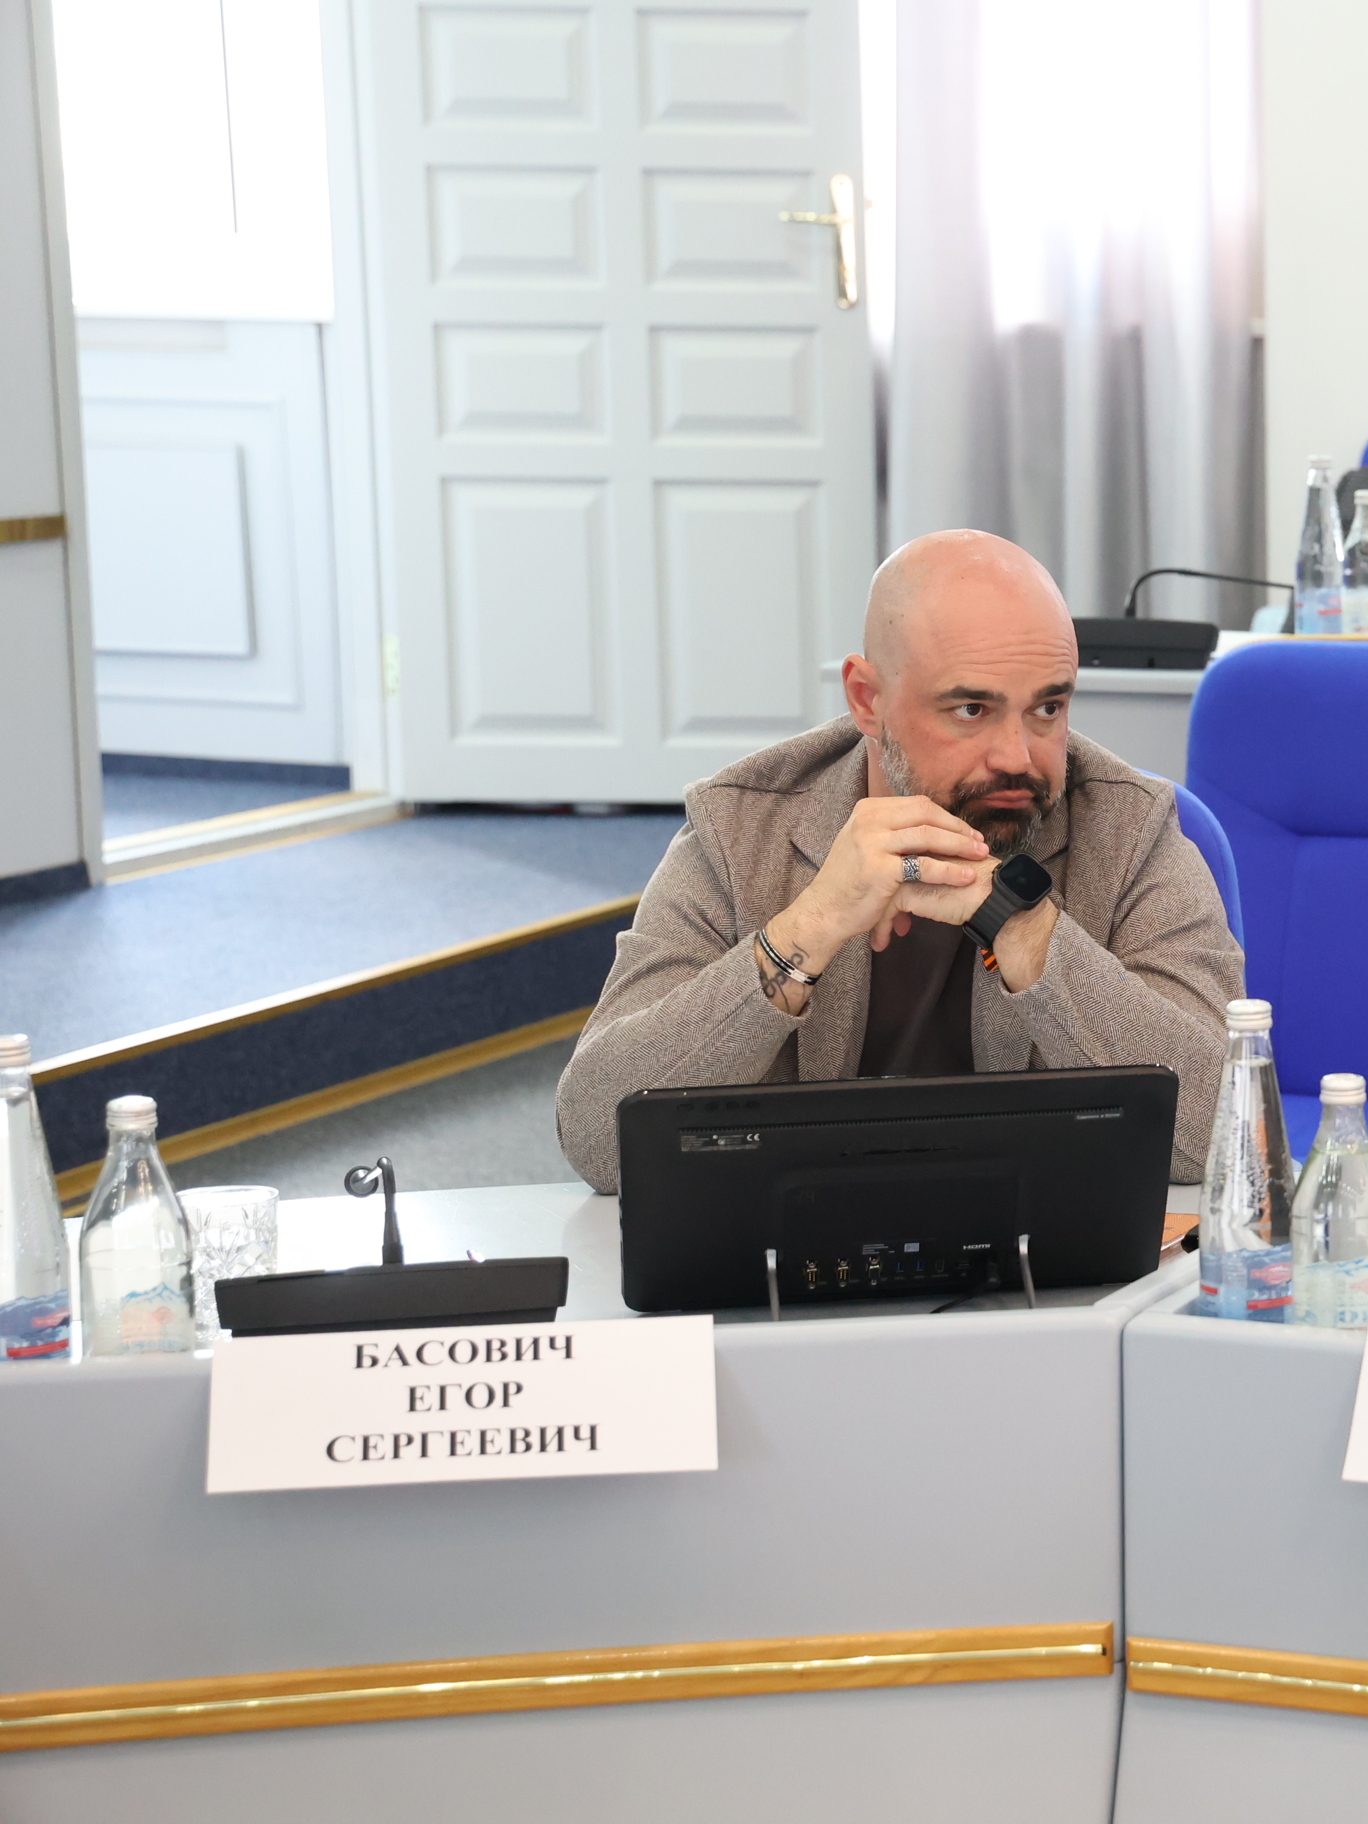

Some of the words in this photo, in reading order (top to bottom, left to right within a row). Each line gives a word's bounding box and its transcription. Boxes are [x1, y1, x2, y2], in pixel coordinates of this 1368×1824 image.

[354, 1334, 574, 1369] БАСОВИЧ
[407, 1381, 524, 1413] ЕГОР
[325, 1424, 600, 1463] СЕРГЕЕВИЧ
